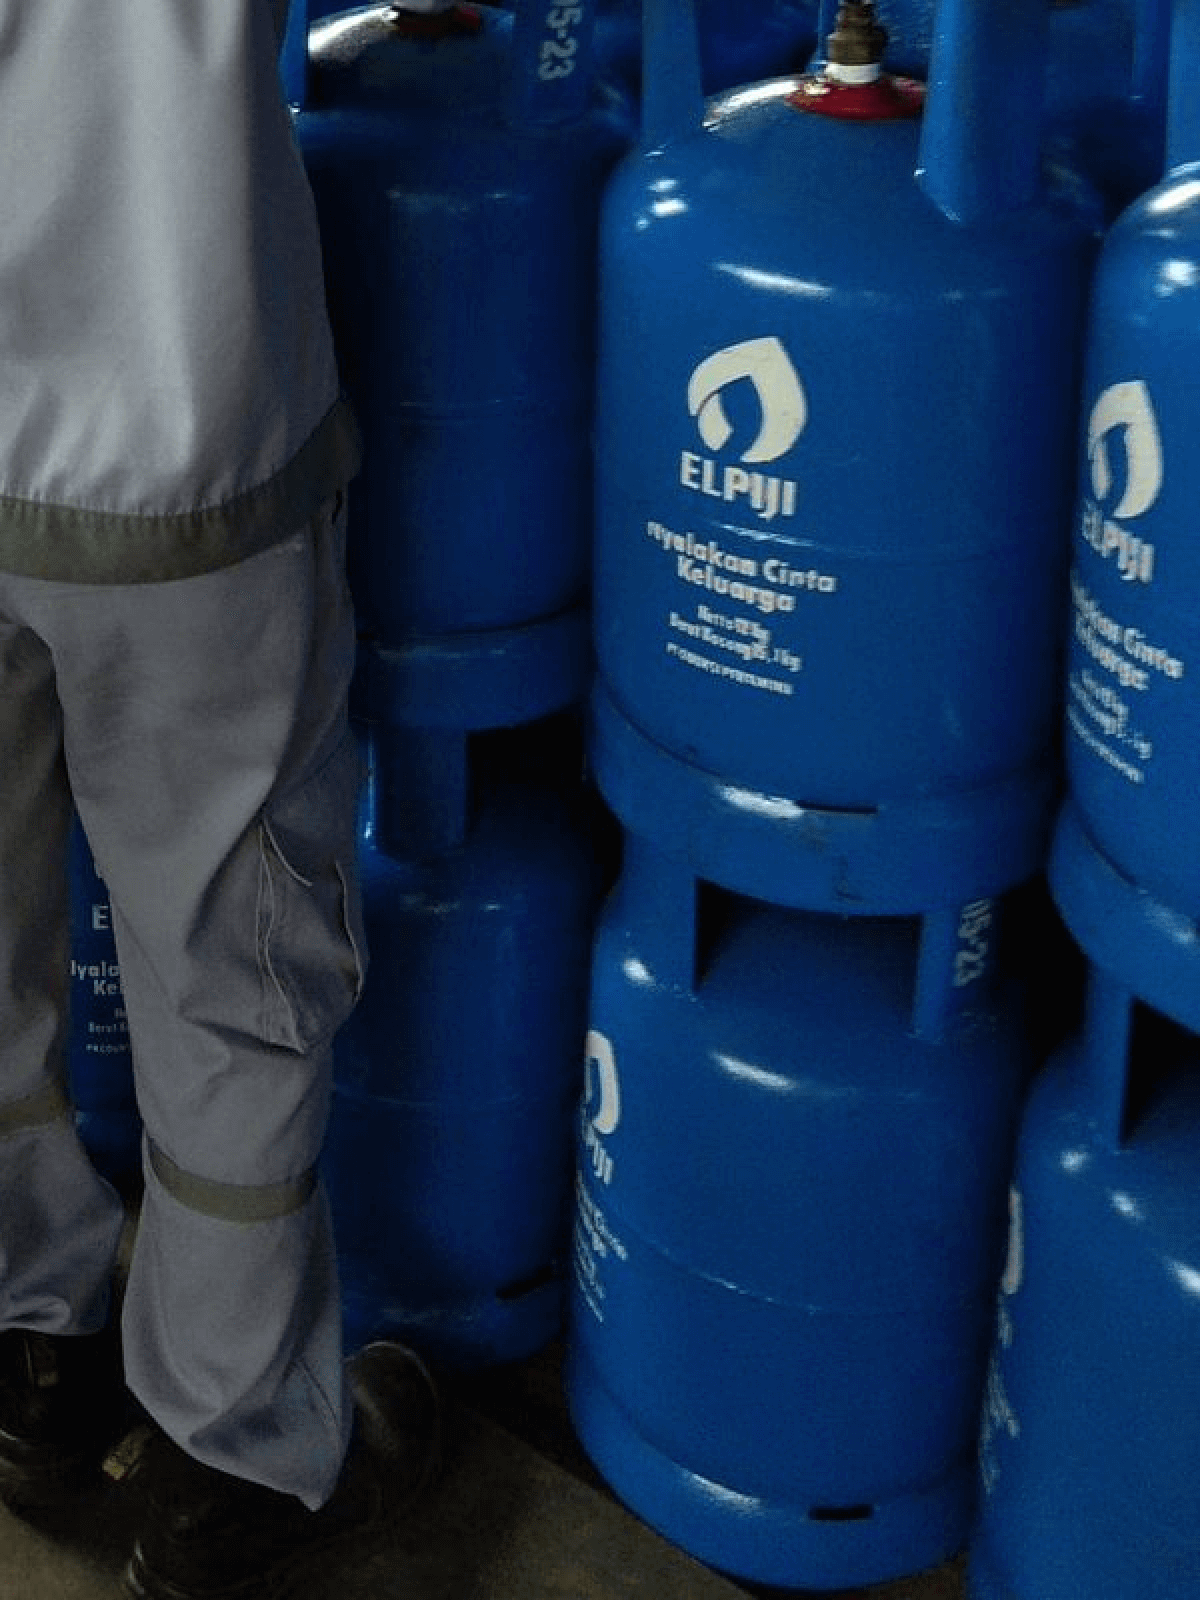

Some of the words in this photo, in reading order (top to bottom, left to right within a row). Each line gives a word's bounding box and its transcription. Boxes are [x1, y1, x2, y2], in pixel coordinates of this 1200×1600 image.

[680, 450, 799, 521] ELPIJI
[676, 554, 796, 614] Keluarga
[762, 558, 838, 593] Cinta
